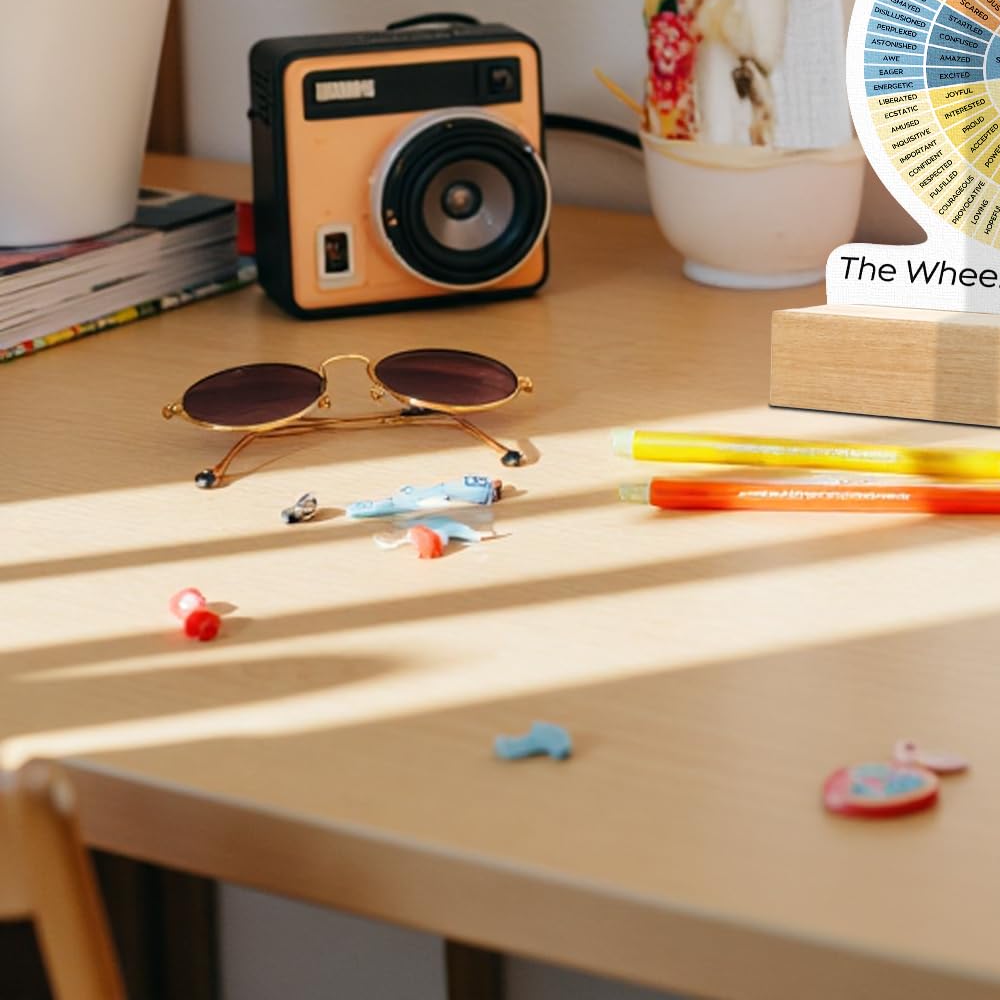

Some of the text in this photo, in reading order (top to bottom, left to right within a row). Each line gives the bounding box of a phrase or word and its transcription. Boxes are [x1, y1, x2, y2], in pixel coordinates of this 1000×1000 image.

[874, 7, 926, 28] DISILLUSIONED
[960, 0, 988, 21] SCARED
[877, 24, 917, 37] PERPLEXED
[949, 15, 983, 35] STARTLED
[872, 39, 917, 50] ASTONISHED
[940, 33, 978, 49] CONFUSED
[940, 55, 971, 63] AMAZED
[874, 82, 913, 90] ENERGETIC
[945, 88, 973, 98] JOYFUL
[879, 94, 917, 105] LIBERATED
[944, 99, 985, 119] INTERESTED
[885, 105, 918, 119] ECSTATIC
[891, 119, 919, 133] AMUSED
[962, 116, 984, 133] PROUD
[892, 128, 931, 149] INQUISITIVE
[970, 123, 999, 153] ACCEPTED
[900, 140, 937, 163] IMPORTANT
[909, 150, 943, 177] CONFIDENT
[919, 160, 953, 188] RESPECTED
[929, 170, 958, 199] FULFILLED
[939, 176, 974, 215] COURAGEOUS
[952, 181, 985, 224] PROVOCATIVE
[971, 199, 989, 225] LOVING
[840, 257, 897, 282] The
